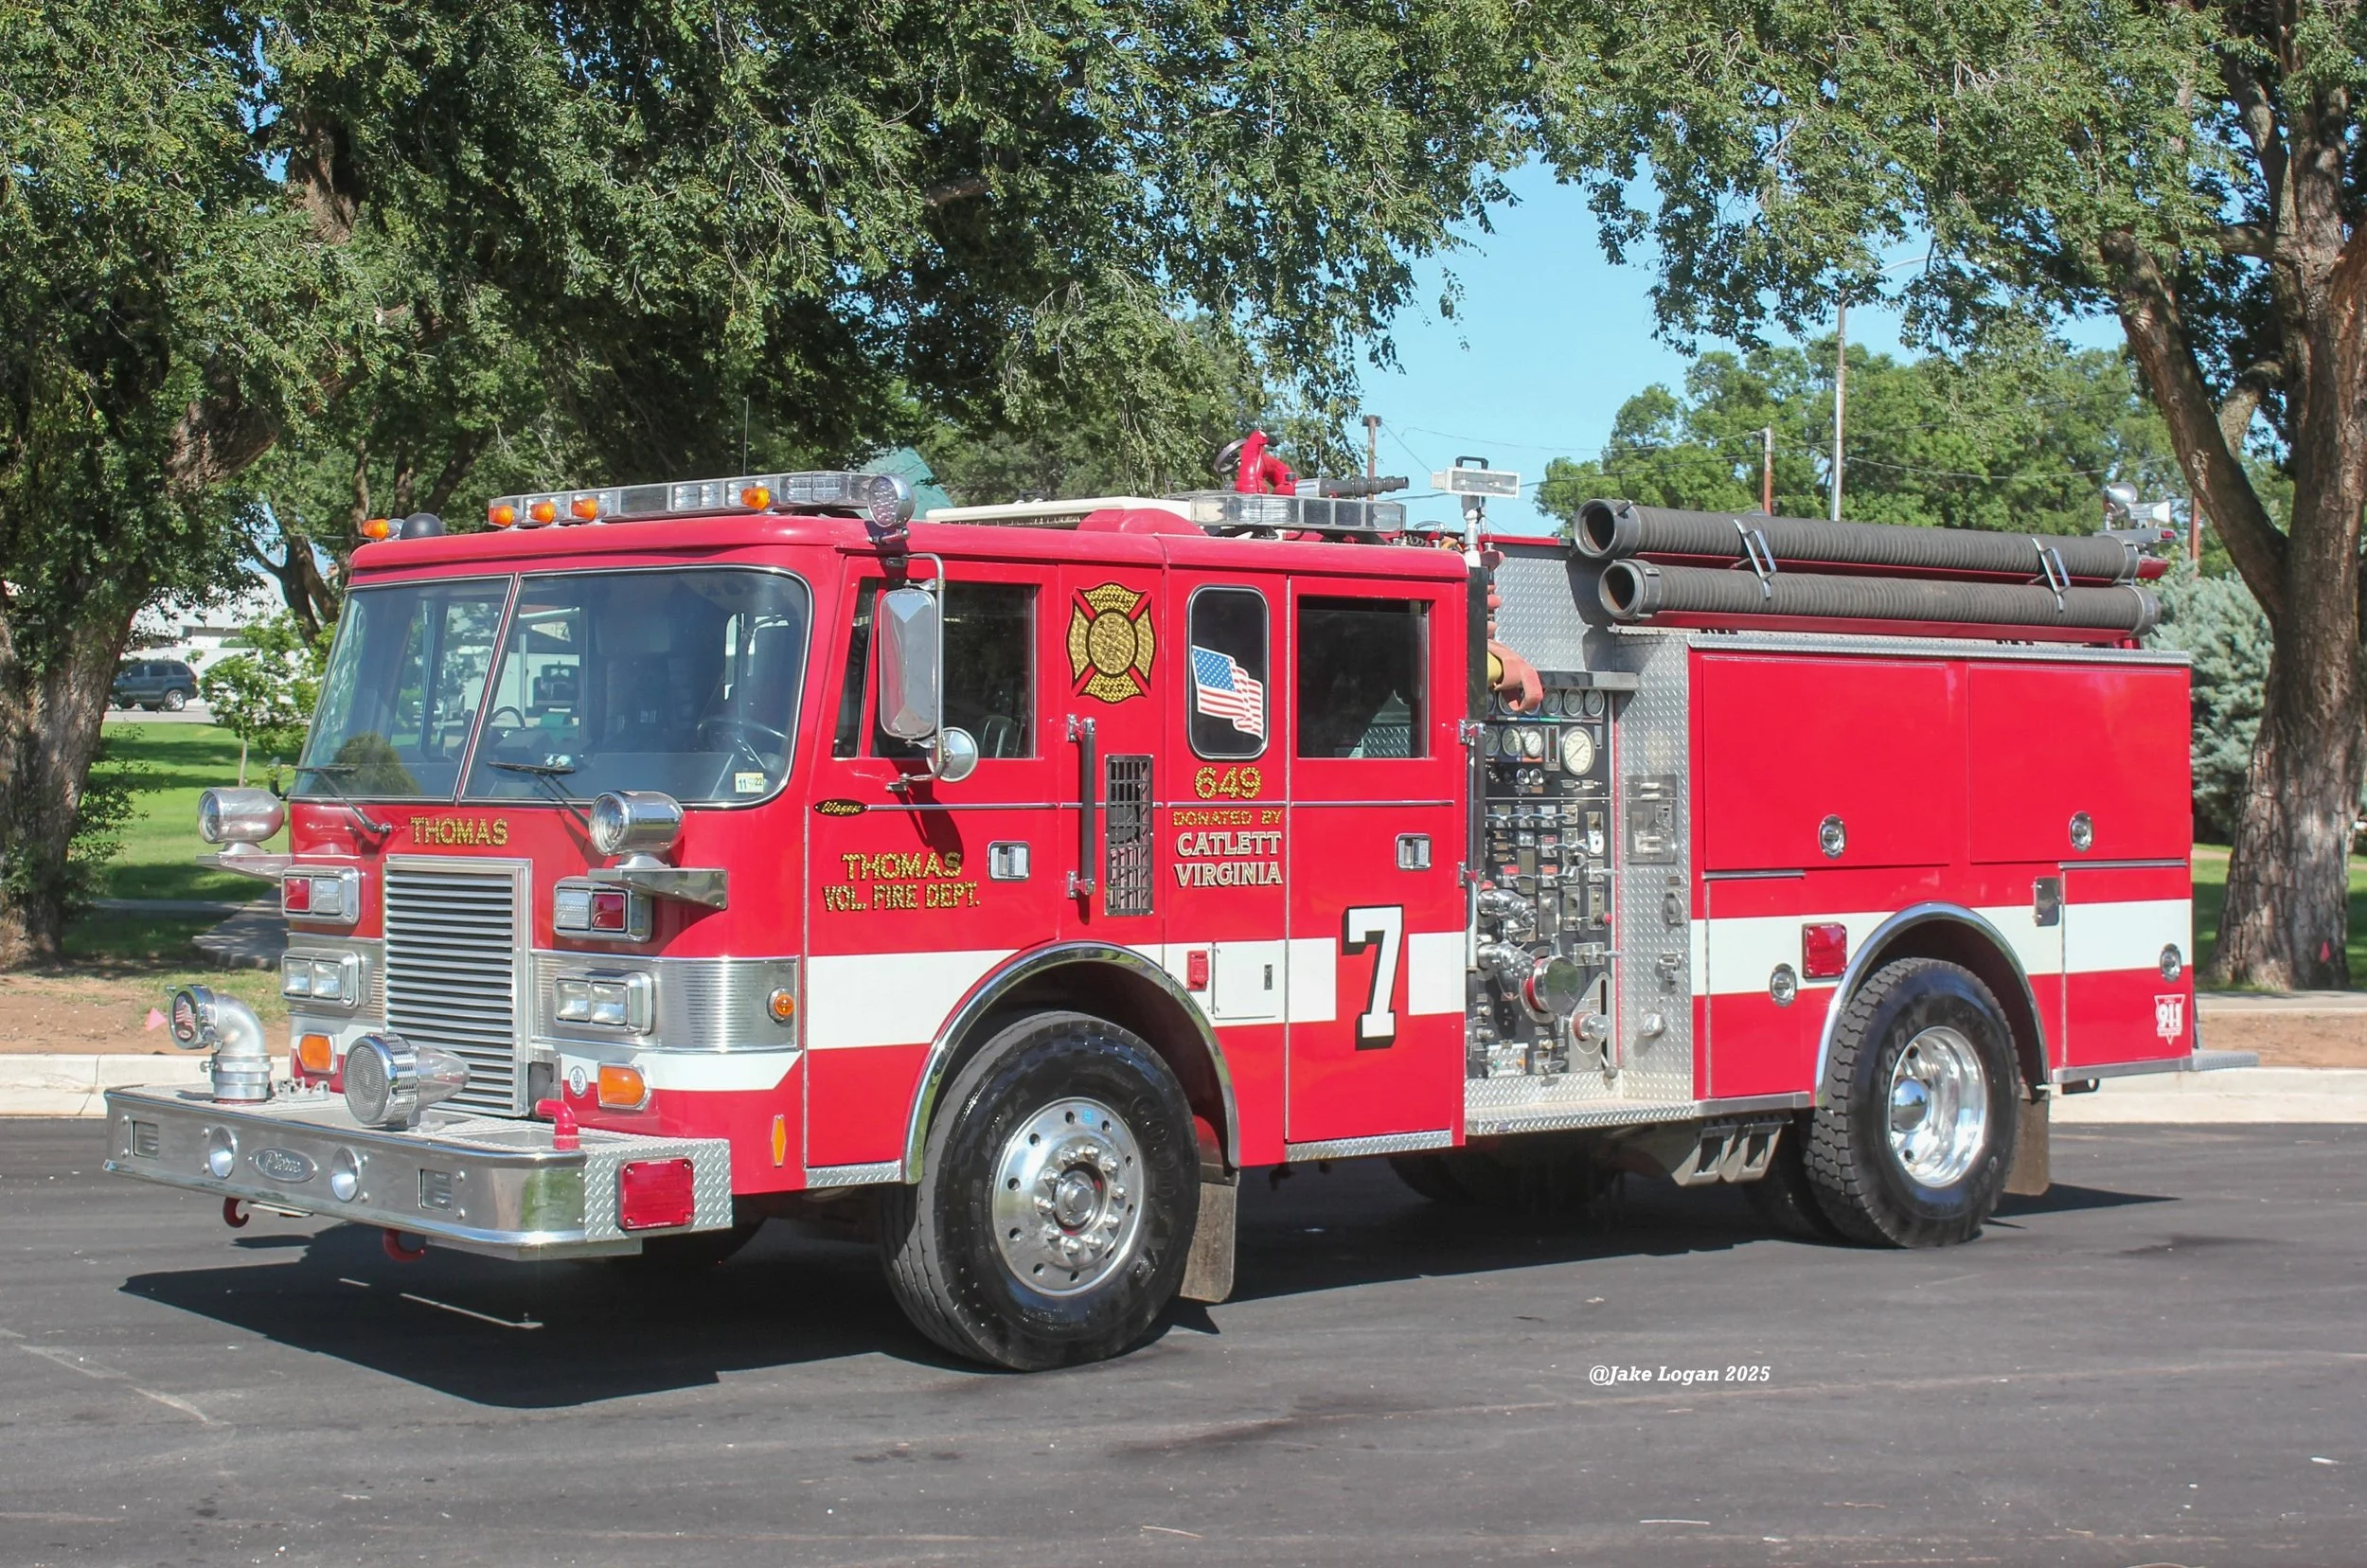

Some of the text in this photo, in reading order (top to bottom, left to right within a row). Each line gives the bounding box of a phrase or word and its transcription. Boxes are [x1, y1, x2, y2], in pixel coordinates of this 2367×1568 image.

[1195, 766, 1261, 799] 649
[409, 816, 508, 846] THOMAS
[1172, 810, 1283, 826] DONATED BY
[1177, 830, 1282, 856] CATLETT
[842, 851, 963, 881] THOMAS
[1174, 861, 1284, 888] VIRGINIA
[822, 881, 981, 912] VOL. FIRE DEPT.
[1343, 904, 1403, 1051] 7
